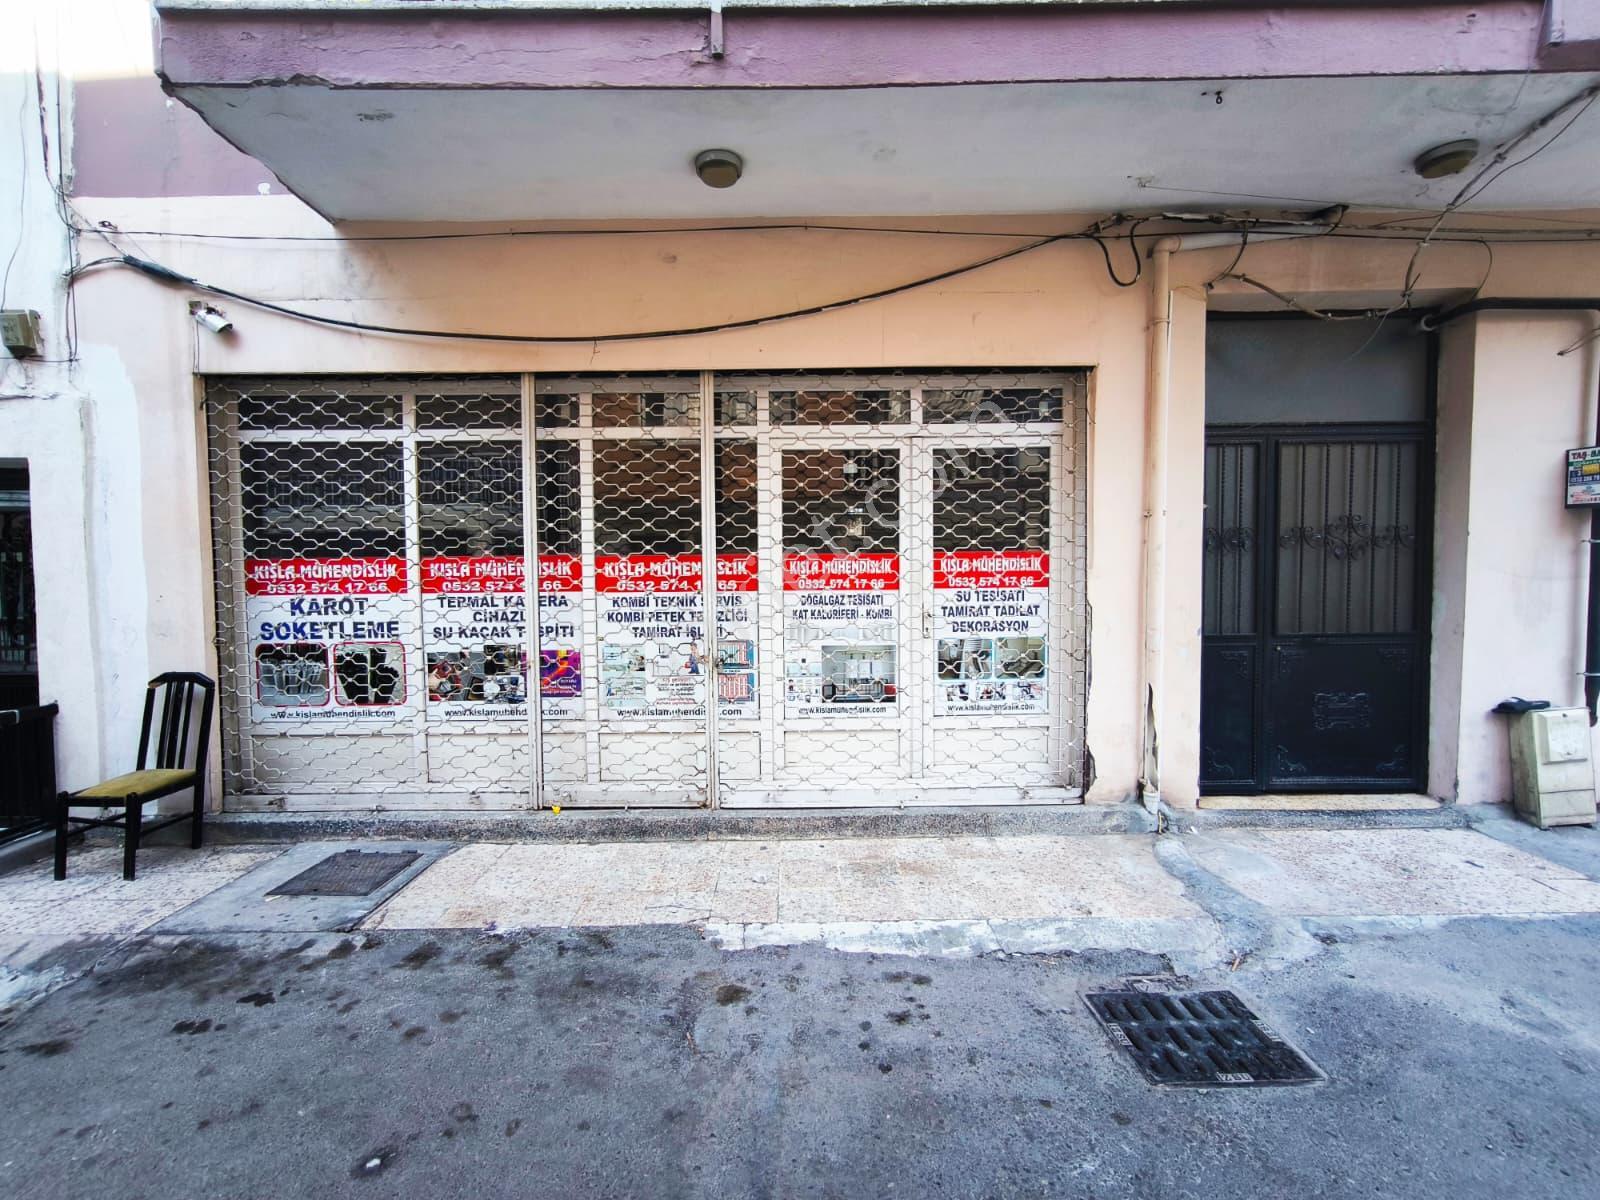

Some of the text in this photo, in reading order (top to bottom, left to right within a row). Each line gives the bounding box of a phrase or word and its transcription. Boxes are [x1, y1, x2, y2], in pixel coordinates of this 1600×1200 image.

[301, 561, 397, 579] MÜHENDİSLİK
[475, 560, 572, 577] MÜHENİSLİK
[604, 560, 747, 579] KIŞLA MÜHENSLİK
[267, 582, 388, 593] 0532 574 17 66
[442, 582, 481, 592] 0532
[485, 582, 514, 591] 574
[543, 581, 562, 590] 66
[617, 580, 655, 591] 0532
[854, 579, 868, 588] 17
[436, 595, 568, 608] TERMAL KAERA
[653, 593, 697, 607] TEKNİK
[956, 590, 971, 602] SU
[290, 597, 368, 616] KAROT
[793, 608, 808, 620] KAT
[260, 621, 399, 640] SOKETLEME
[433, 626, 453, 639] SU
[952, 621, 1029, 633] DEKORASYON
